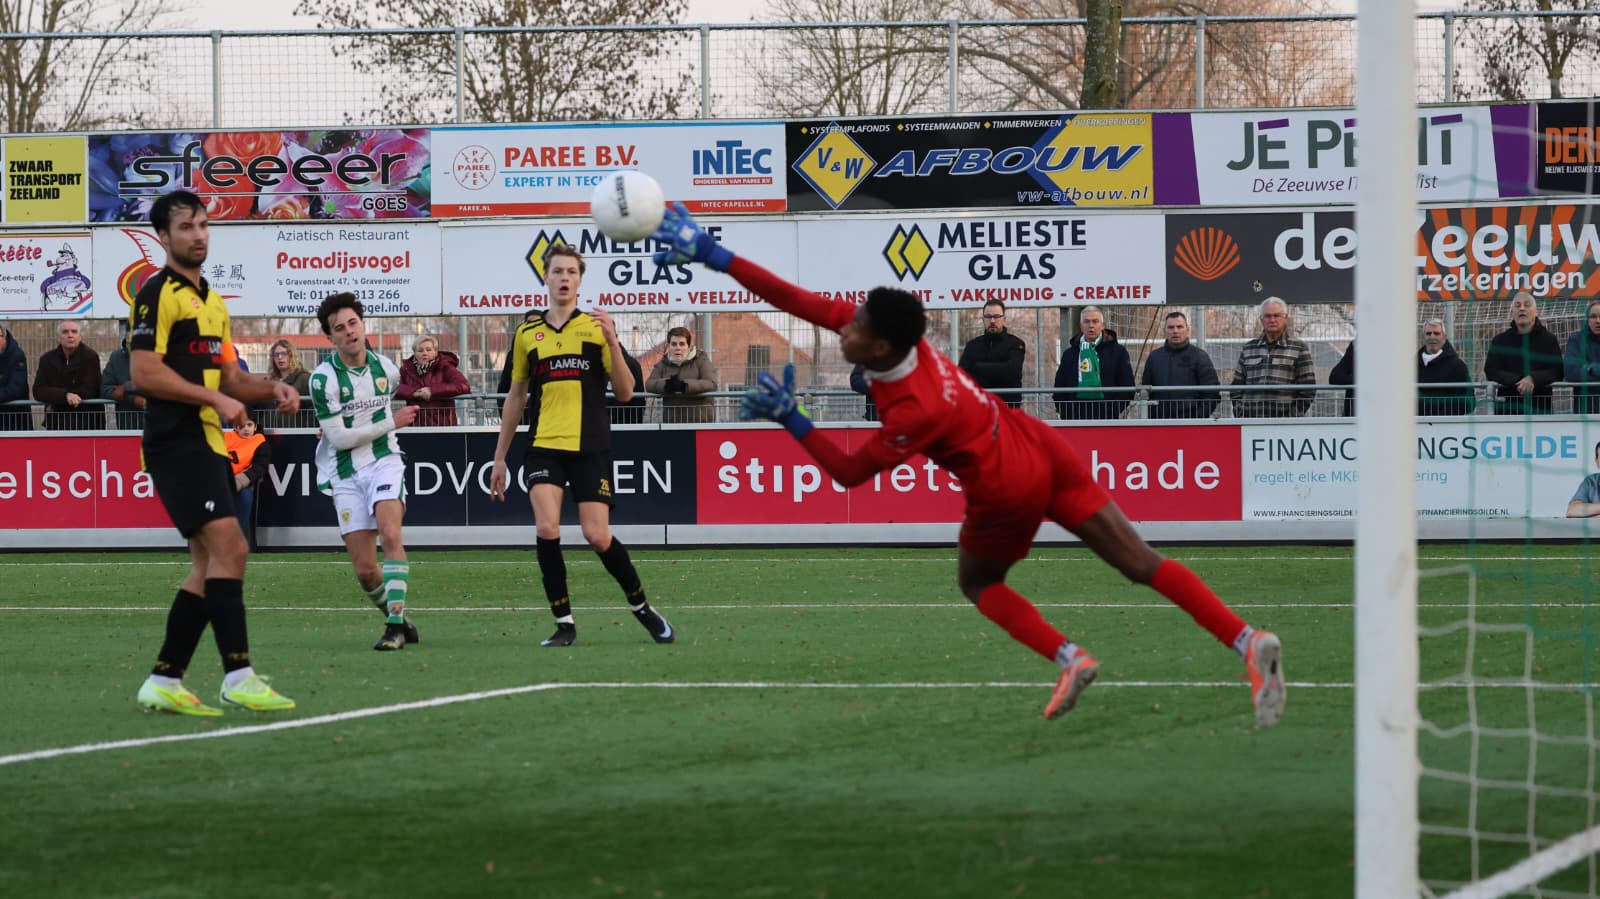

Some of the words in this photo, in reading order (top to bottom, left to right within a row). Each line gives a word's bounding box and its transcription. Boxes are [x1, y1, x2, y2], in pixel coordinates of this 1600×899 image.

[810, 124, 890, 135] SYSTEEMPLAFONDS
[904, 121, 981, 132] SYSTEEMWANDEN
[992, 119, 1061, 129] TIMMERWERKEN
[1226, 118, 1289, 171] JE
[1546, 127, 1600, 163] DER
[119, 141, 407, 190] sfeeeer
[505, 145, 585, 169] PAREE
[596, 144, 638, 169] B.V.
[693, 140, 772, 175] INTEC
[874, 145, 1145, 177] AFBOUW
[9, 160, 53, 173] ZWAAR
[9, 173, 82, 187] TRANSPORT
[505, 177, 553, 191] EXPERT
[558, 176, 571, 189] IN
[1252, 178, 1273, 193] Dé
[1279, 175, 1344, 192] Zeeuwse
[9, 188, 60, 200] ZEELAND
[1017, 186, 1149, 204] vw-afbouw.nl
[363, 197, 407, 211] GOES
[277, 230, 334, 242] Aziatisch
[339, 229, 410, 241] Restaurant
[938, 219, 1087, 249] MELIESTE
[276, 250, 410, 273] Paradijsvogel
[968, 253, 1057, 281] GLAS
[200, 263, 246, 281] 華鳳
[608, 259, 693, 286] GLAS
[285, 278, 336, 286] Gravenstraat
[337, 278, 350, 286] 47,
[360, 277, 410, 286] Gravenpolder
[1417, 267, 1586, 298] rzekeringen
[288, 290, 306, 300] Tel:
[378, 290, 400, 299] 266
[599, 292, 669, 306] MODERN
[688, 290, 768, 305] VEELZIJD
[951, 287, 1054, 303] VAKKUNDIG
[1073, 285, 1152, 300] CREATIEF
[1254, 471, 1294, 485] regelt
[1299, 470, 1327, 483] elke
